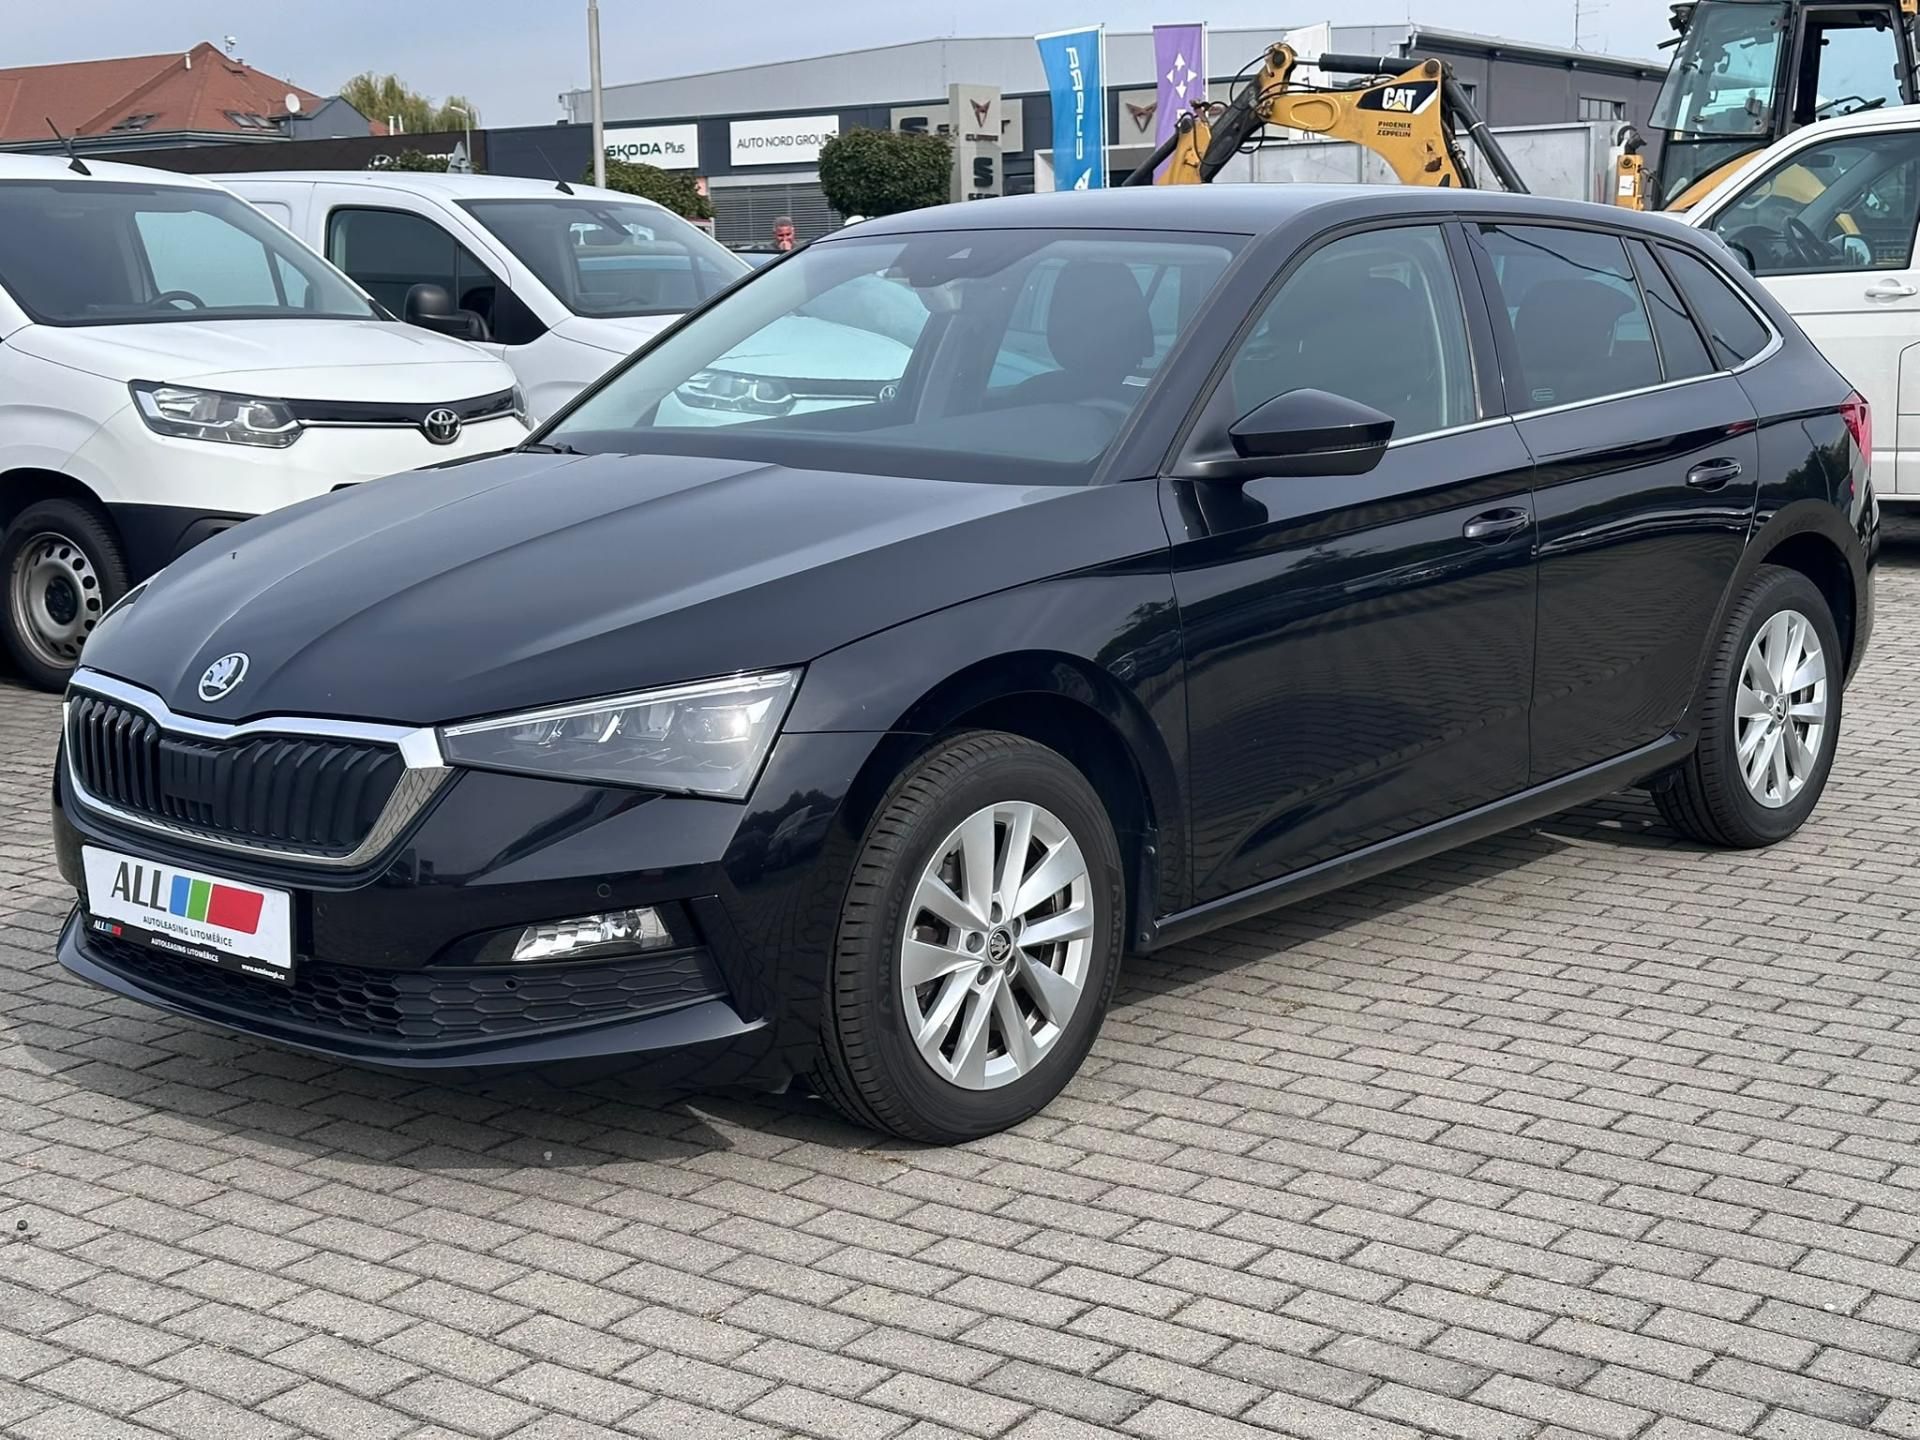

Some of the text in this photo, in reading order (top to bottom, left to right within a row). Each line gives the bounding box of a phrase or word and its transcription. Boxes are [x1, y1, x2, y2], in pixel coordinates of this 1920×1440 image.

[1382, 87, 1416, 111] CAT
[1377, 121, 1411, 129] PHOENIX
[1377, 129, 1411, 138] ZEPPELIN
[665, 141, 685, 154] Plus
[737, 136, 764, 149] AUTO
[766, 135, 793, 147] NORD
[110, 861, 167, 912] ALL
[142, 915, 189, 936] AUTOLEASING
[151, 937, 187, 954] AUTOLEASING
